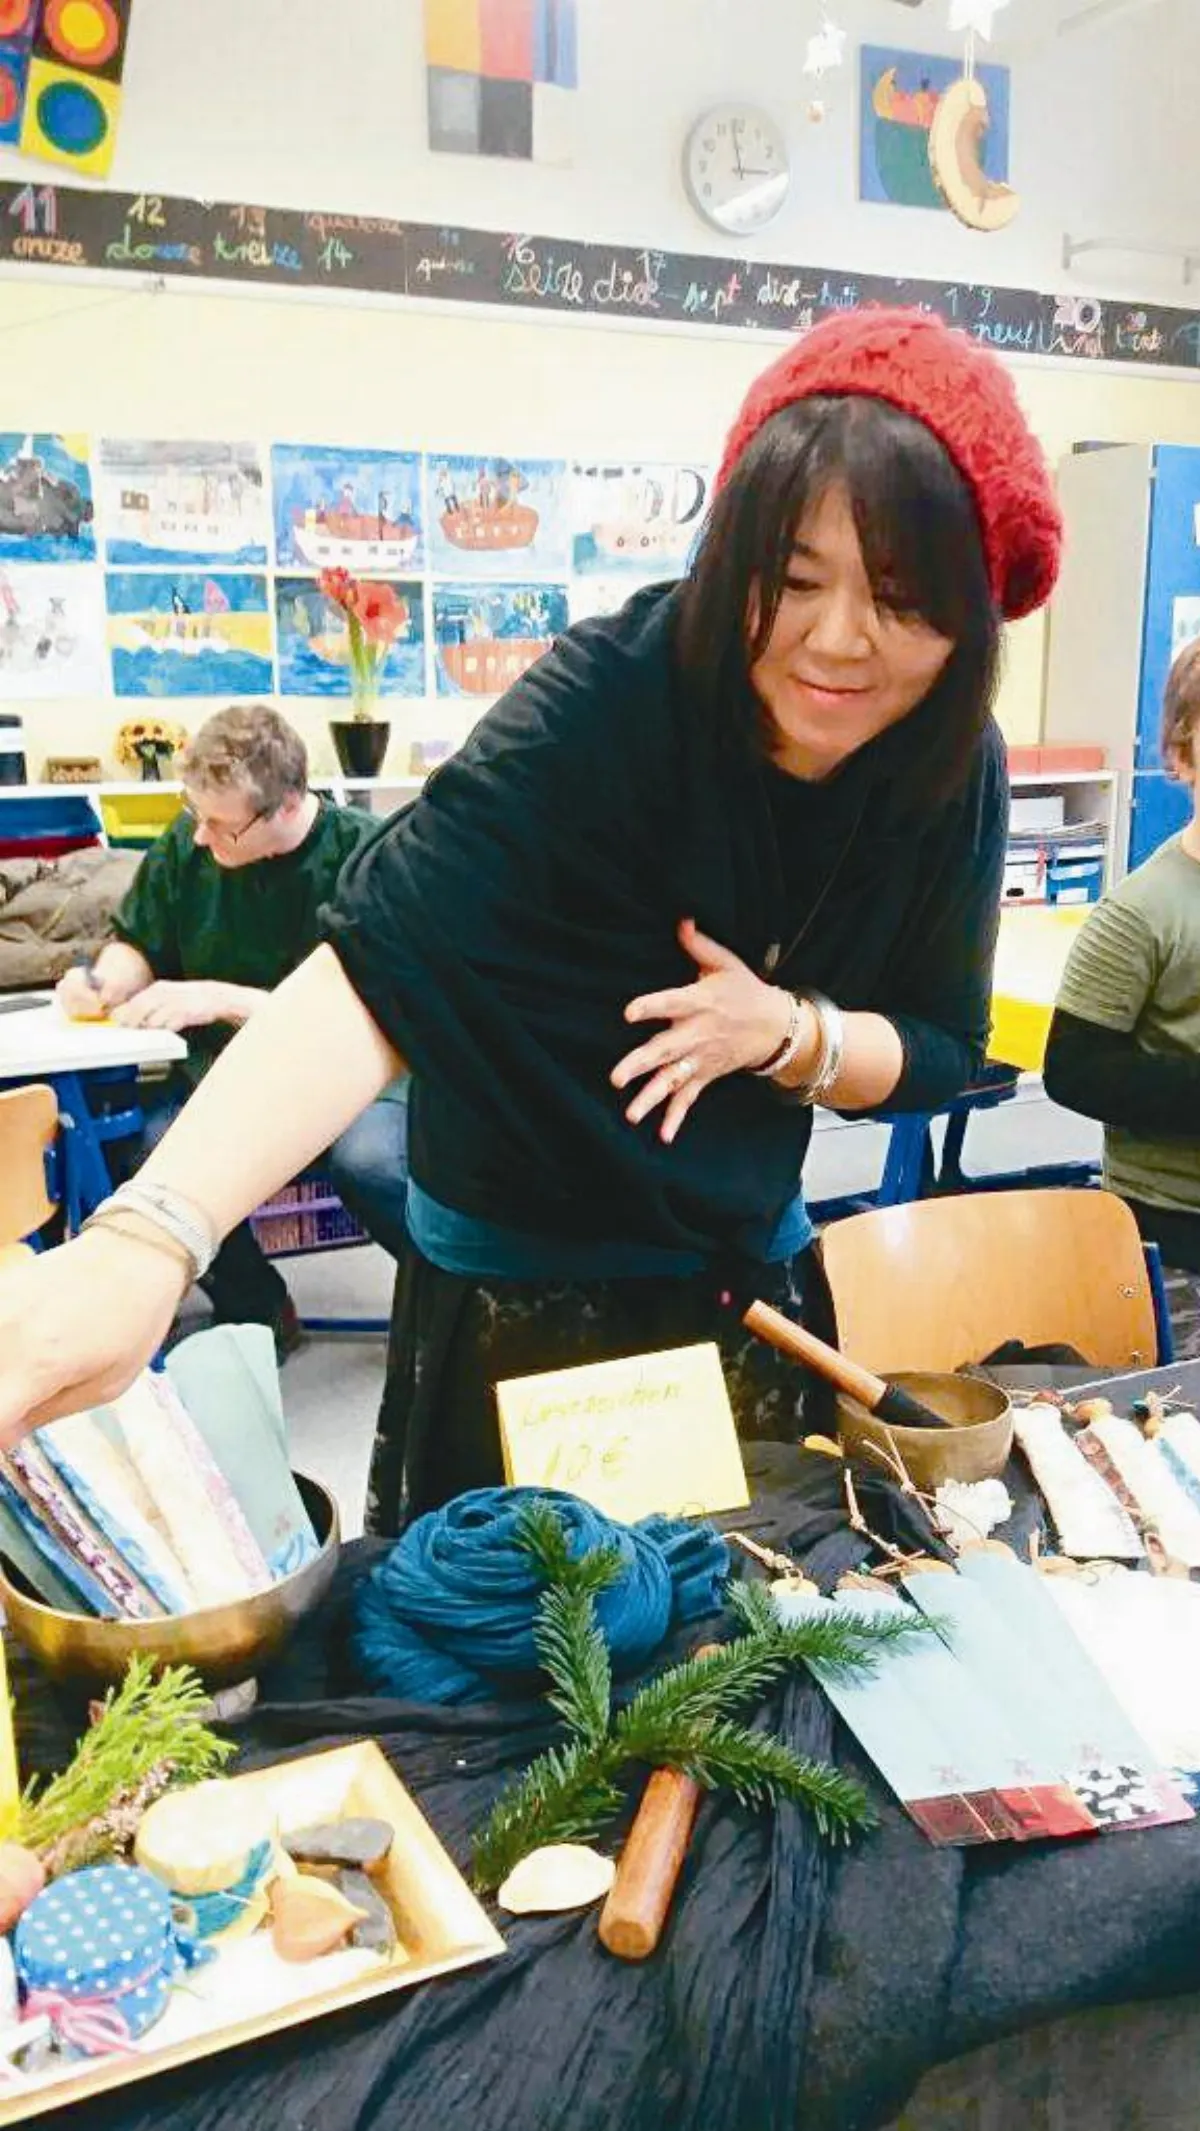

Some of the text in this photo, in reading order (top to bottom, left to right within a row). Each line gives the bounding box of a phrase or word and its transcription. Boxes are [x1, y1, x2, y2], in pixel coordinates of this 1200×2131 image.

[8, 183, 57, 233] 11
[127, 192, 167, 227] 12
[317, 237, 353, 273] 14
[501, 233, 535, 264] 16
[504, 259, 584, 305] seize
